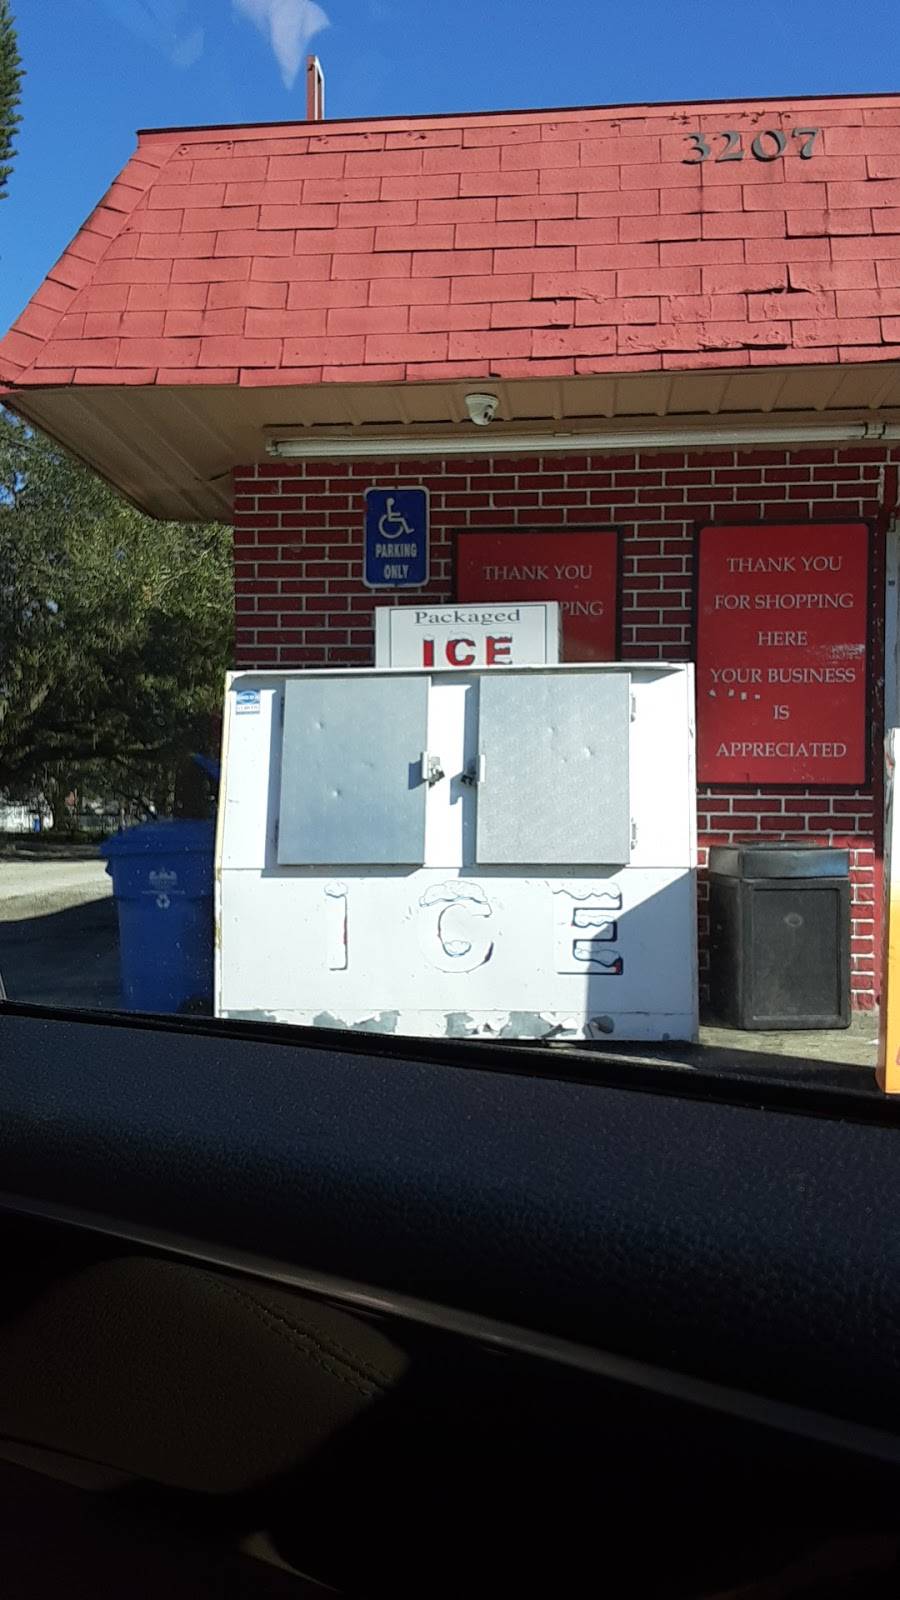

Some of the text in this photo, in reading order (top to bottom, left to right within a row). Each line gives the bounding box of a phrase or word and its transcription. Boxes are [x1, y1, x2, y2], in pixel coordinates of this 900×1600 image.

[681, 127, 820, 164] 3207
[375, 543, 417, 559] PARKING
[383, 564, 409, 579] ONLY
[727, 556, 843, 573] THANK YOU
[483, 565, 593, 581] THANK YOU
[561, 600, 604, 617] PING
[714, 593, 855, 610] FOR SHOPPING
[414, 608, 521, 627] Packaged
[757, 631, 808, 646] HERE
[422, 632, 514, 667] ICE
[710, 667, 856, 683] YOUR BUSINESS
[772, 704, 790, 720] IS
[715, 742, 847, 758] APPRECIATED
